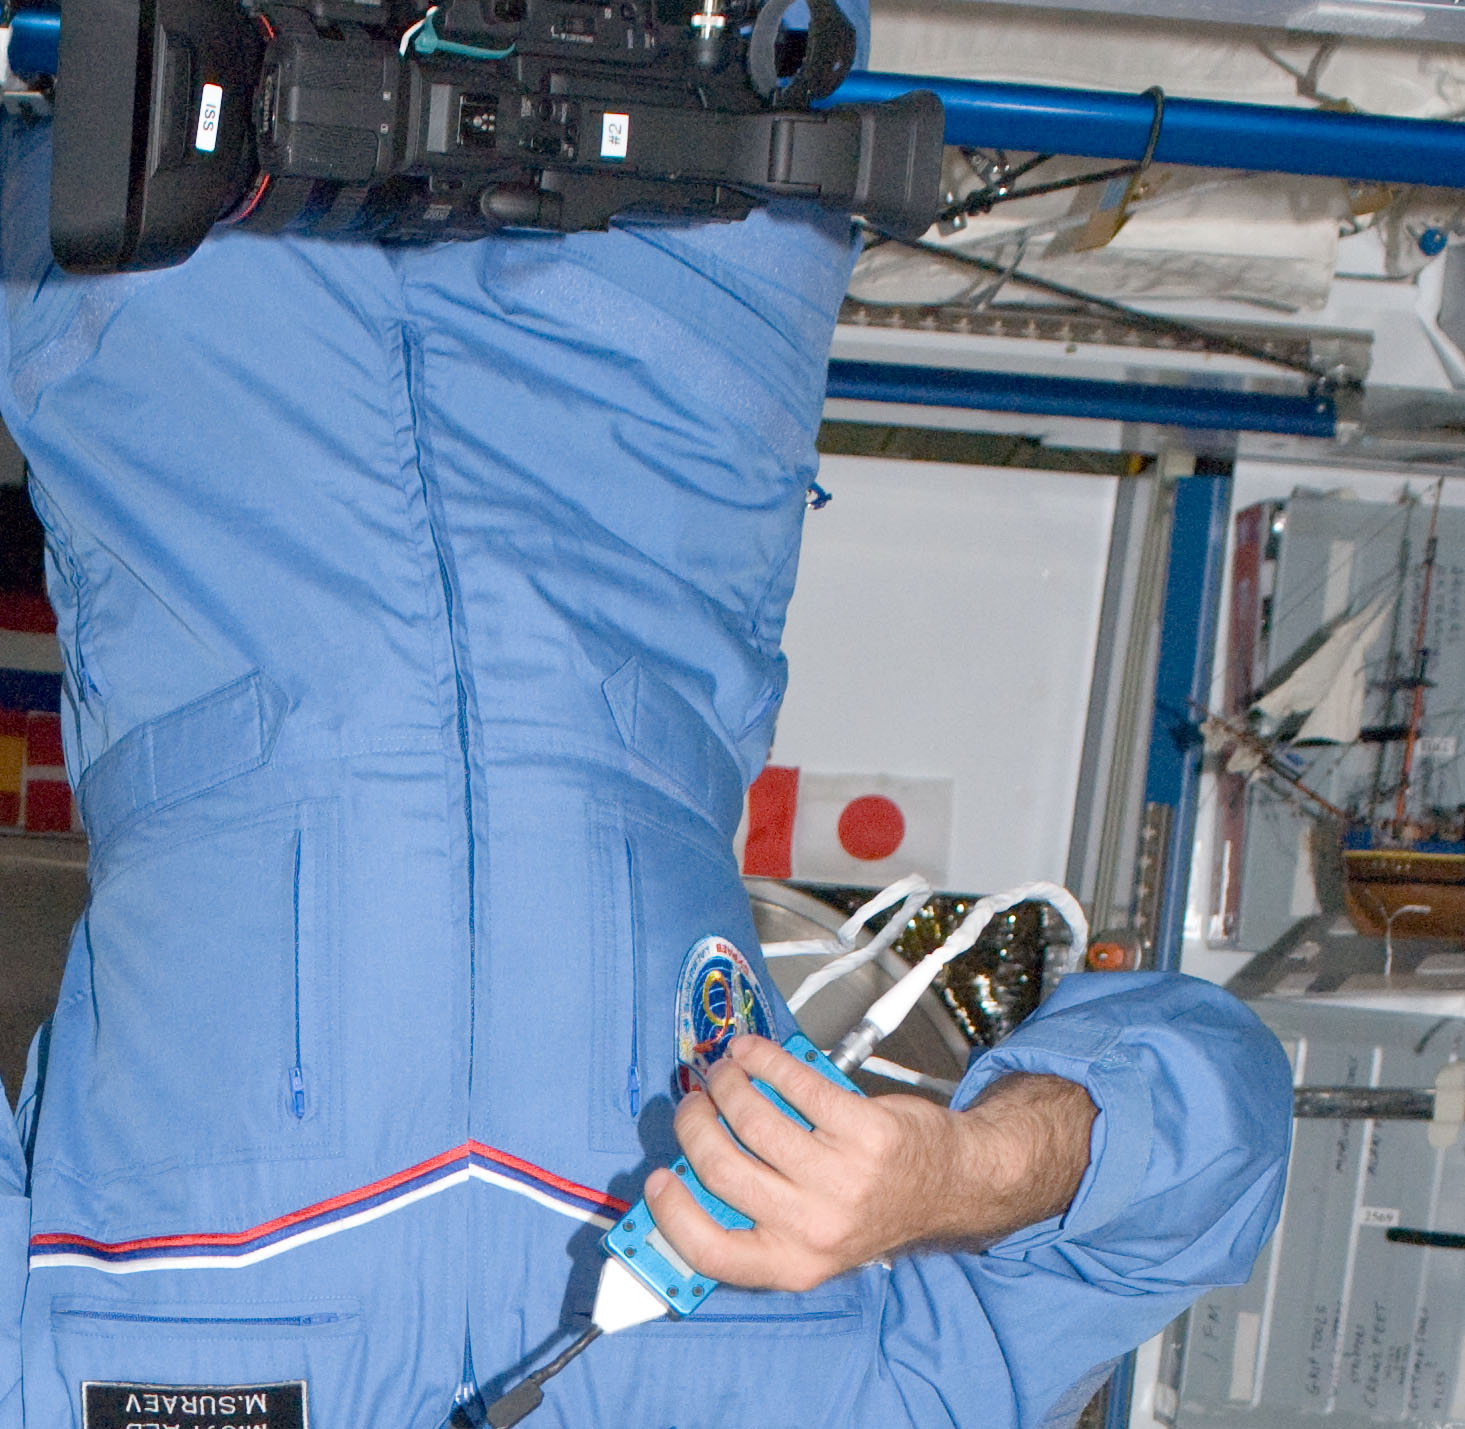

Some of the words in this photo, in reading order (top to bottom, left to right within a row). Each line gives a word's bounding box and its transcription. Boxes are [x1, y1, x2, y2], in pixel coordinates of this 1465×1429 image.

[203, 104, 216, 131] ISS
[608, 123, 623, 145] #2
[125, 1393, 267, 1416] M.SURAEV
